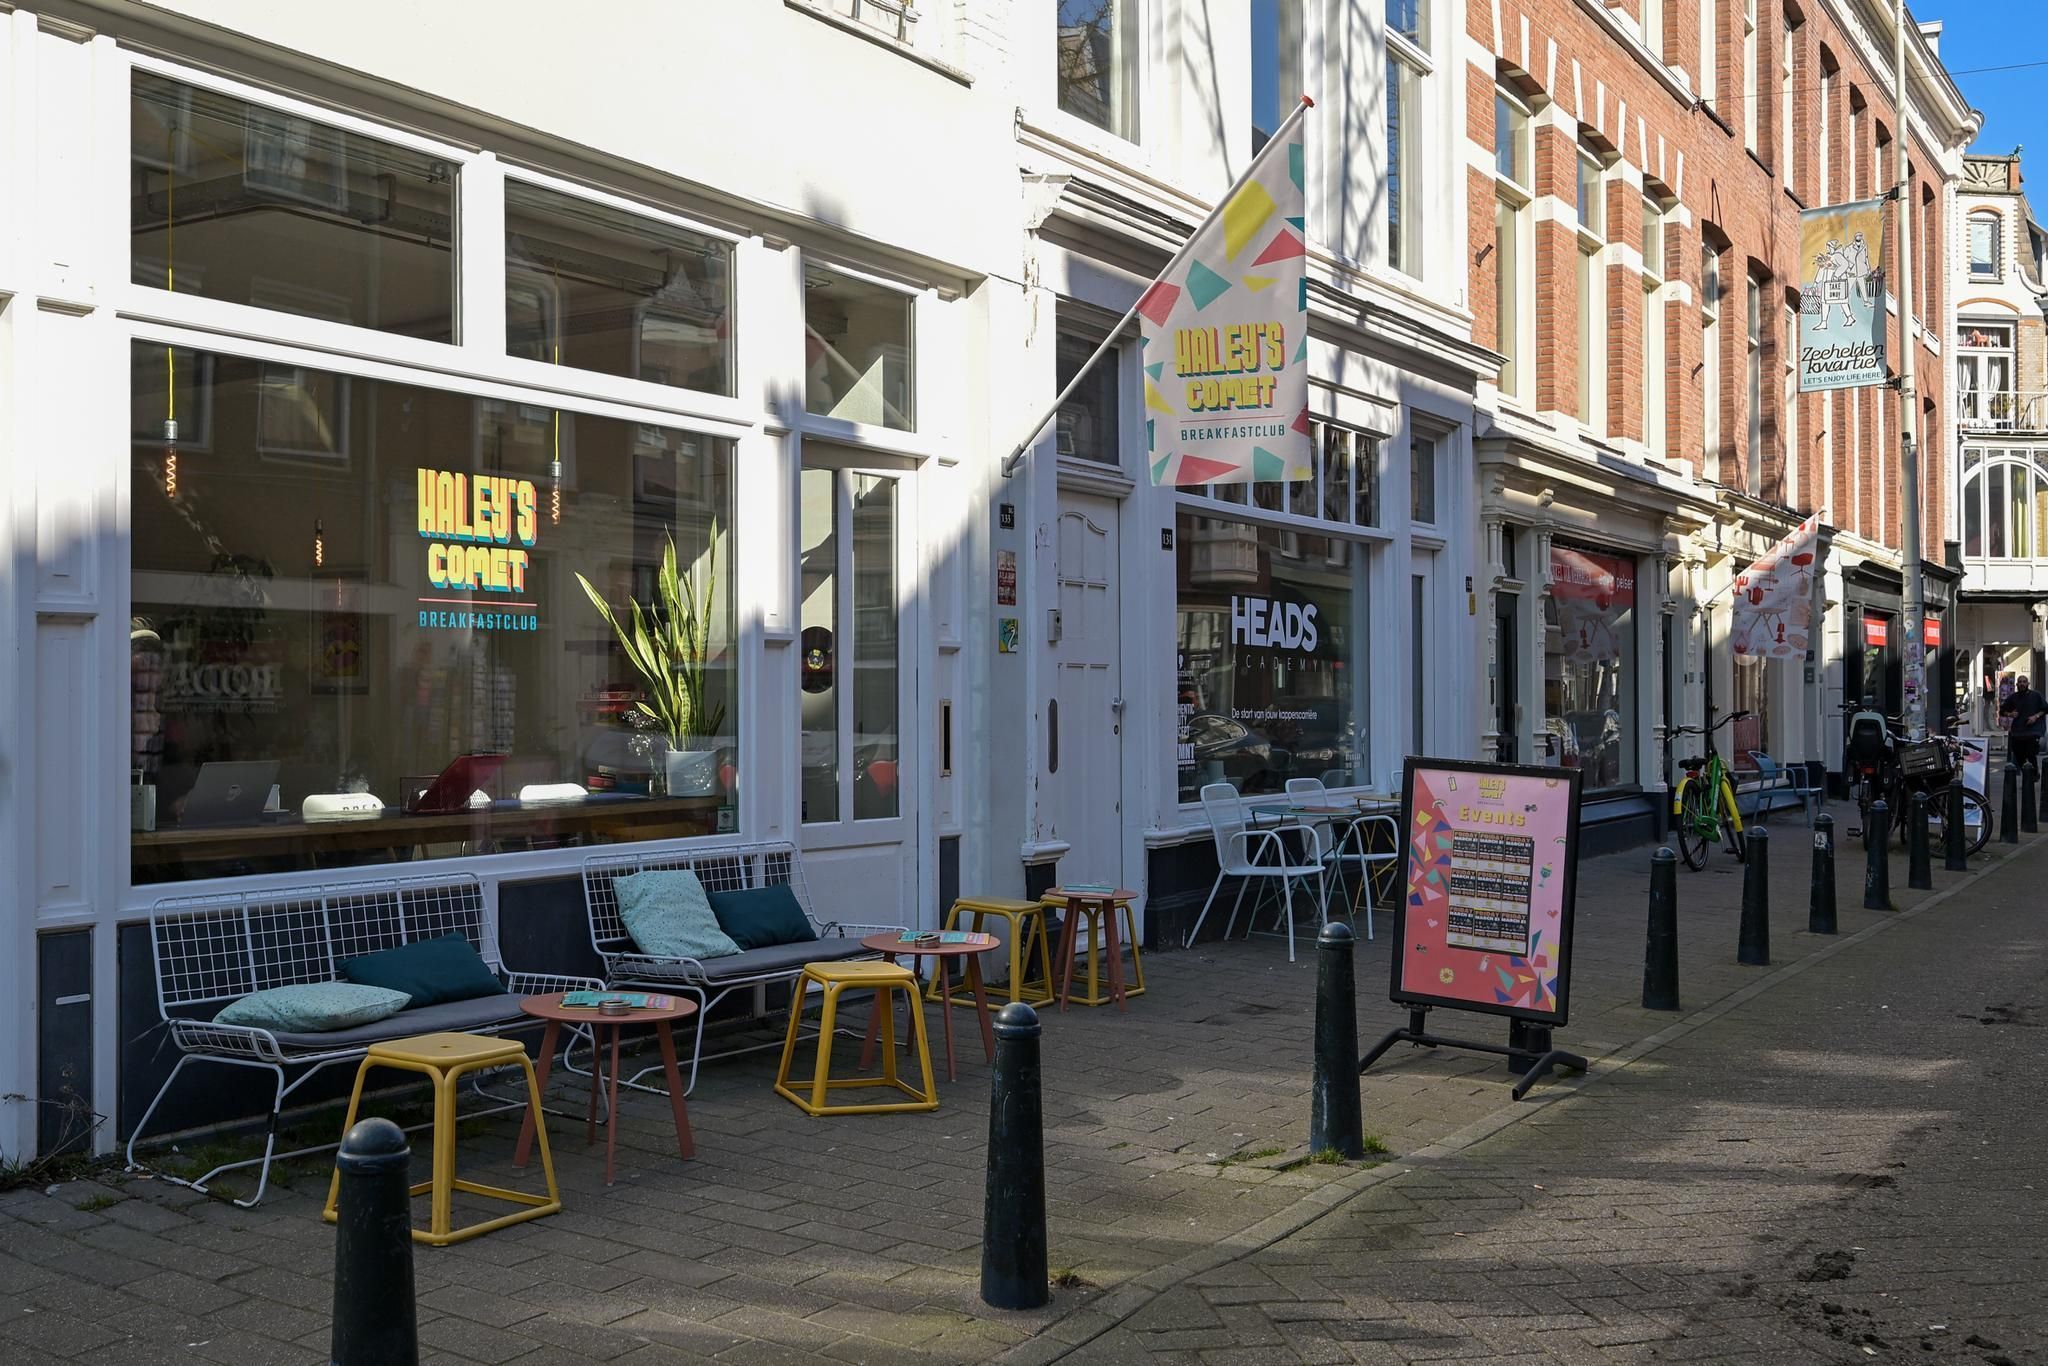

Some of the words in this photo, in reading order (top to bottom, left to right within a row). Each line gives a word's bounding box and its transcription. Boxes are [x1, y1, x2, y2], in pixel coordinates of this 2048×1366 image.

[1829, 282, 1841, 290] TAKE
[1174, 320, 1285, 378] HALEY'S
[1801, 341, 1884, 362] Zeehelden
[1806, 356, 1883, 374] kwartier
[1804, 376, 1822, 385] LET'S
[1823, 374, 1846, 382] ENJOY
[1846, 373, 1861, 381] LIFE
[1186, 375, 1277, 413] COMET
[1181, 424, 1285, 441] BREAKFASTCLUB
[418, 468, 537, 546] HALEY'S
[428, 543, 528, 593] COMET
[419, 611, 537, 630] BREAKFASTCLUB
[1231, 595, 1318, 652] HEADS
[1231, 653, 1318, 672] ACADEMY
[1177, 703, 1195, 715] HENTIC
[1232, 707, 1239, 719] De
[1241, 708, 1253, 719] start
[1254, 710, 1264, 719] van
[1264, 709, 1278, 722] jouw
[1178, 742, 1195, 759] MNT
[1458, 804, 1526, 827] Events
